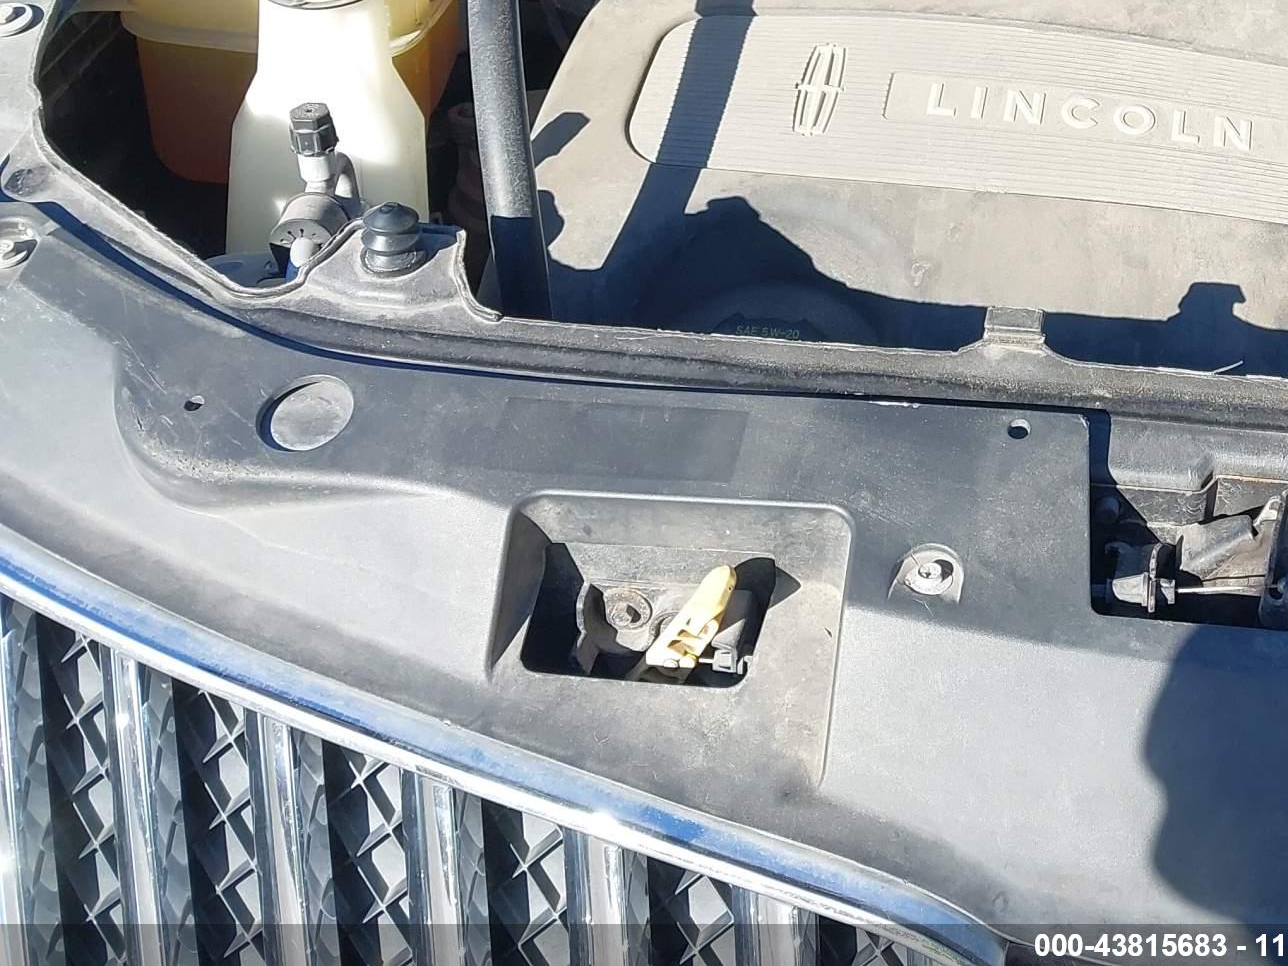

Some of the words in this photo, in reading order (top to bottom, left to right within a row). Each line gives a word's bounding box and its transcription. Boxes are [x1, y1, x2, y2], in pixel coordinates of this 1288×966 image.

[925, 81, 1253, 152] LINCOLN
[735, 324, 758, 336] SAE
[761, 326, 800, 340] 5W-20
